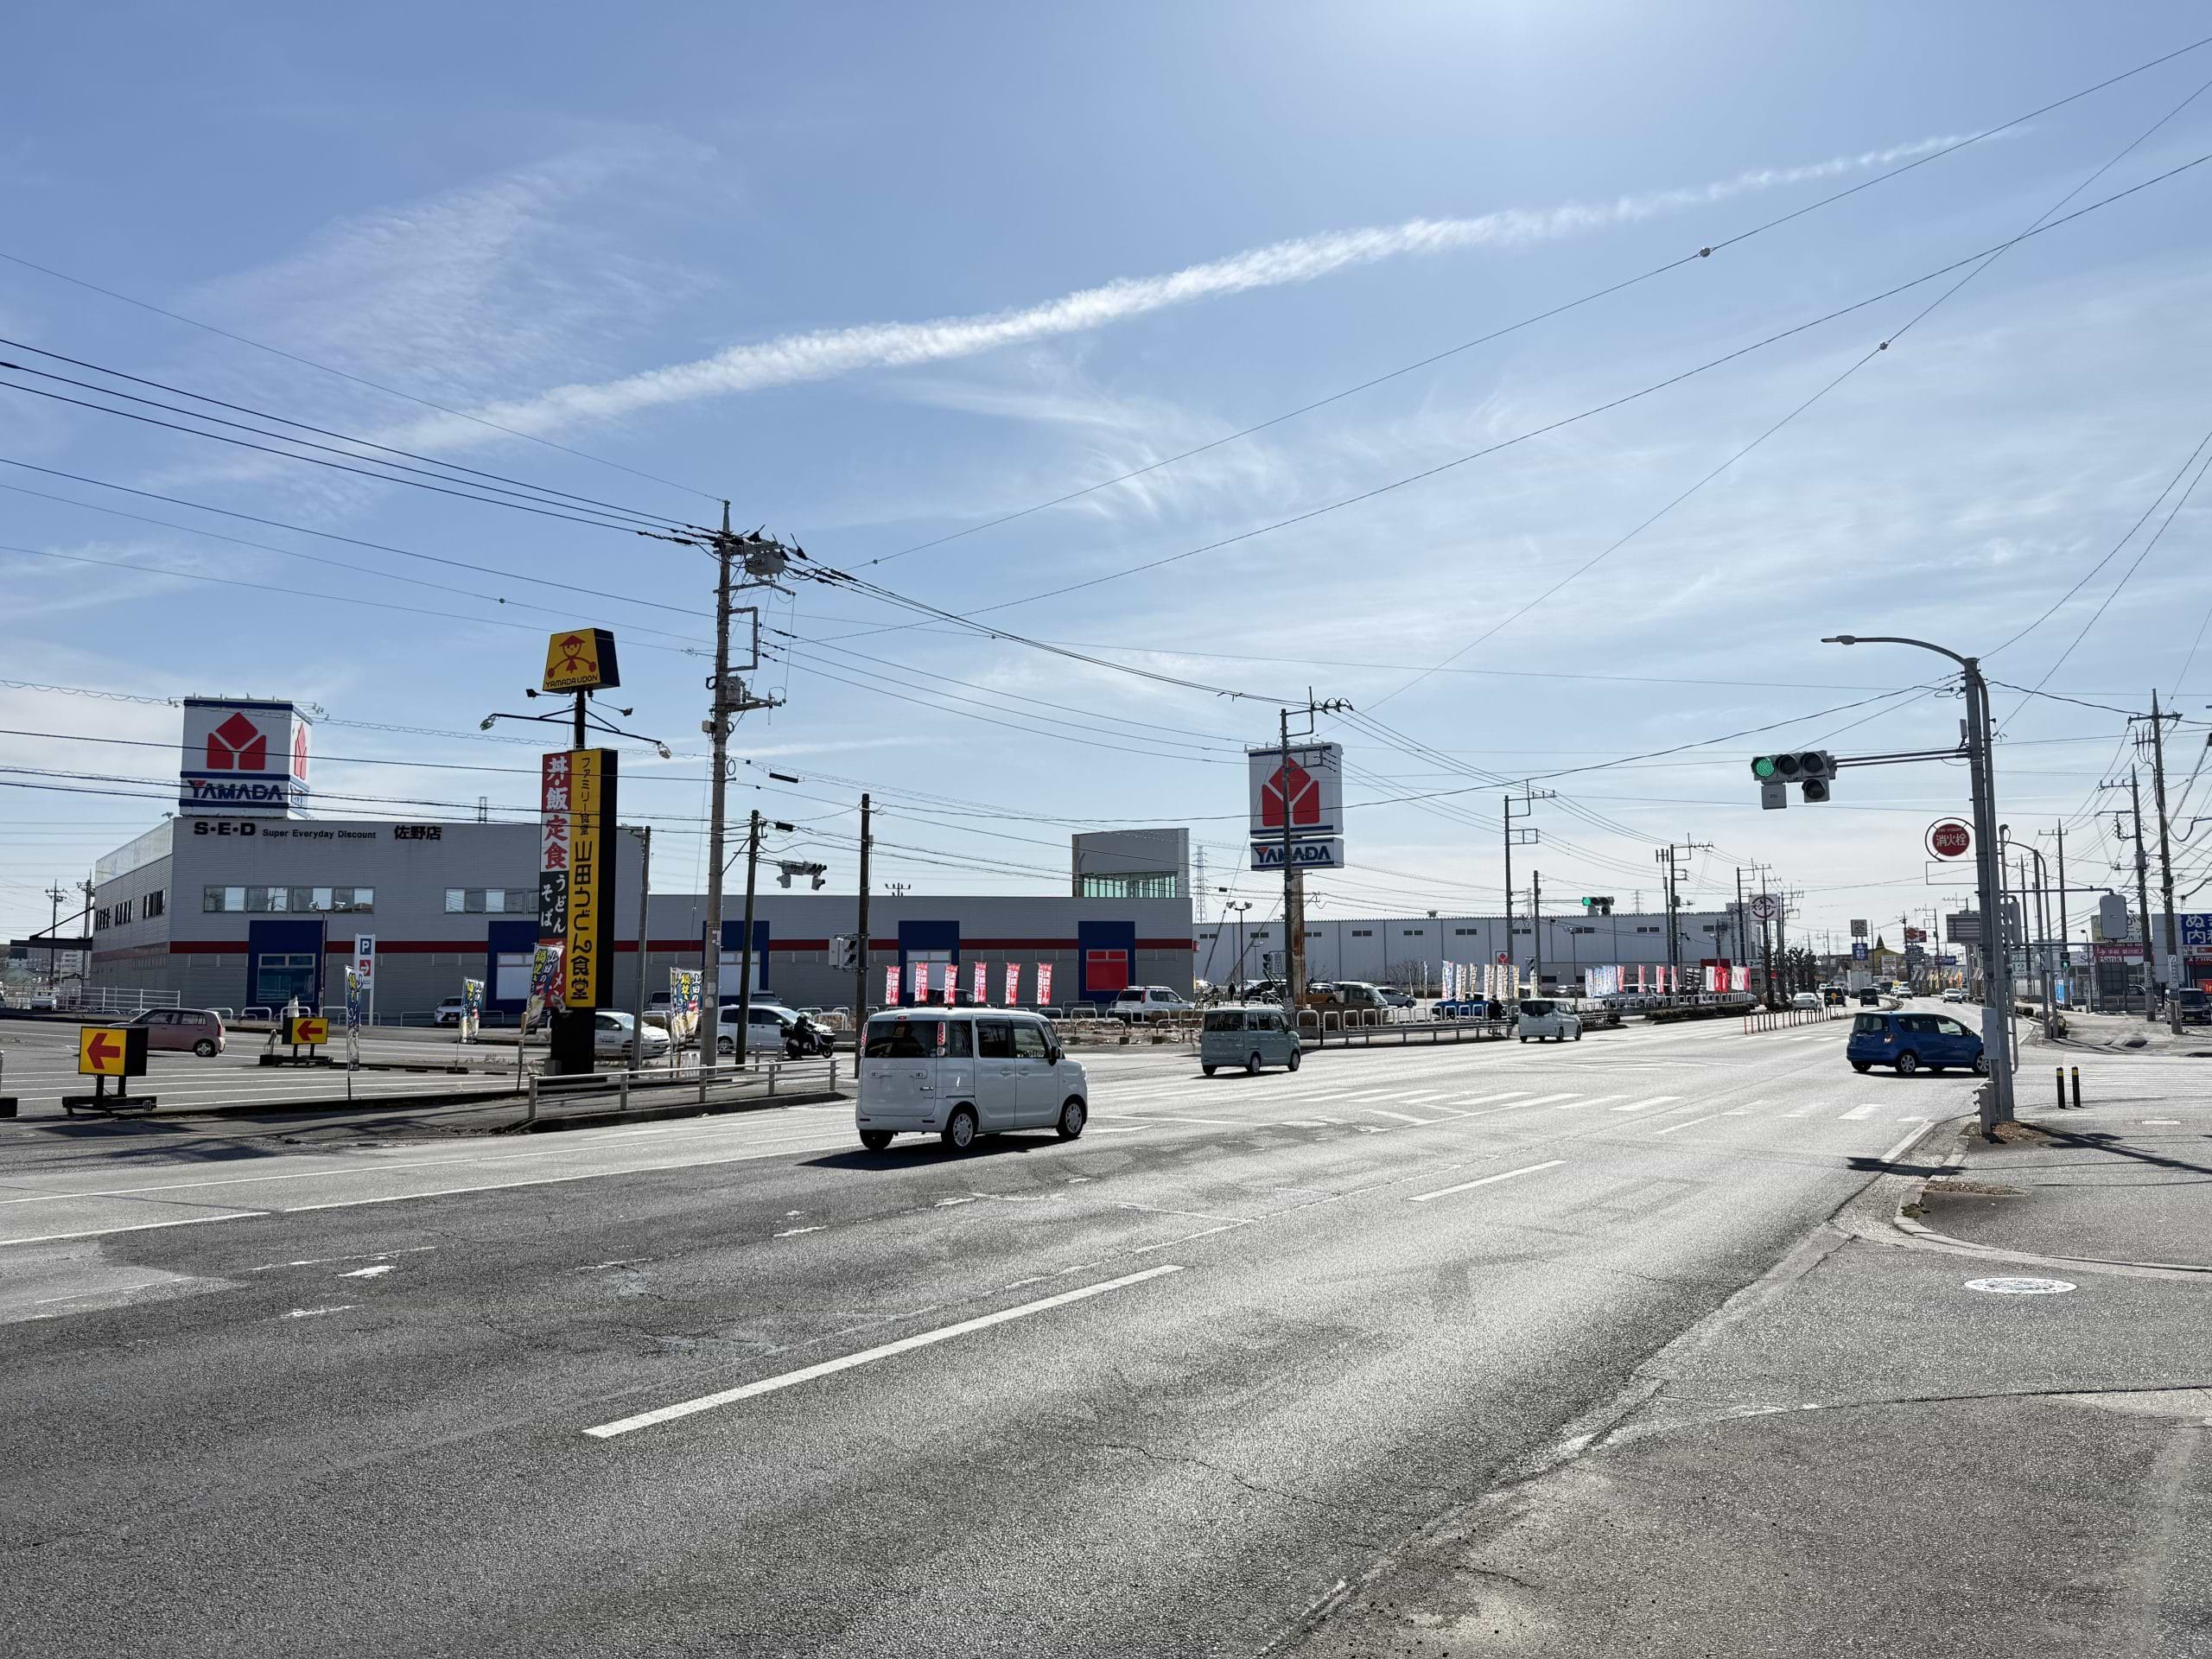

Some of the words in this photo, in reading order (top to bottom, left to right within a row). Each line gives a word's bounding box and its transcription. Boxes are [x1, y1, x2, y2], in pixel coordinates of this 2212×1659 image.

[545, 679, 575, 688] YAMADA
[576, 674, 598, 684] UDON
[188, 779, 283, 801] YAMADA
[580, 758, 591, 836] ファミリー食堂
[262, 829, 289, 838] Super
[292, 830, 334, 840] Everyday
[337, 830, 377, 839] Discount
[394, 824, 442, 841] 佐野店
[543, 814, 569, 870] 定食
[1936, 833, 1967, 847] 消火栓
[540, 884, 553, 927] そば
[553, 874, 566, 934] うどん
[570, 840, 593, 1001] 山田うどん食堂
[361, 940, 370, 953] P
